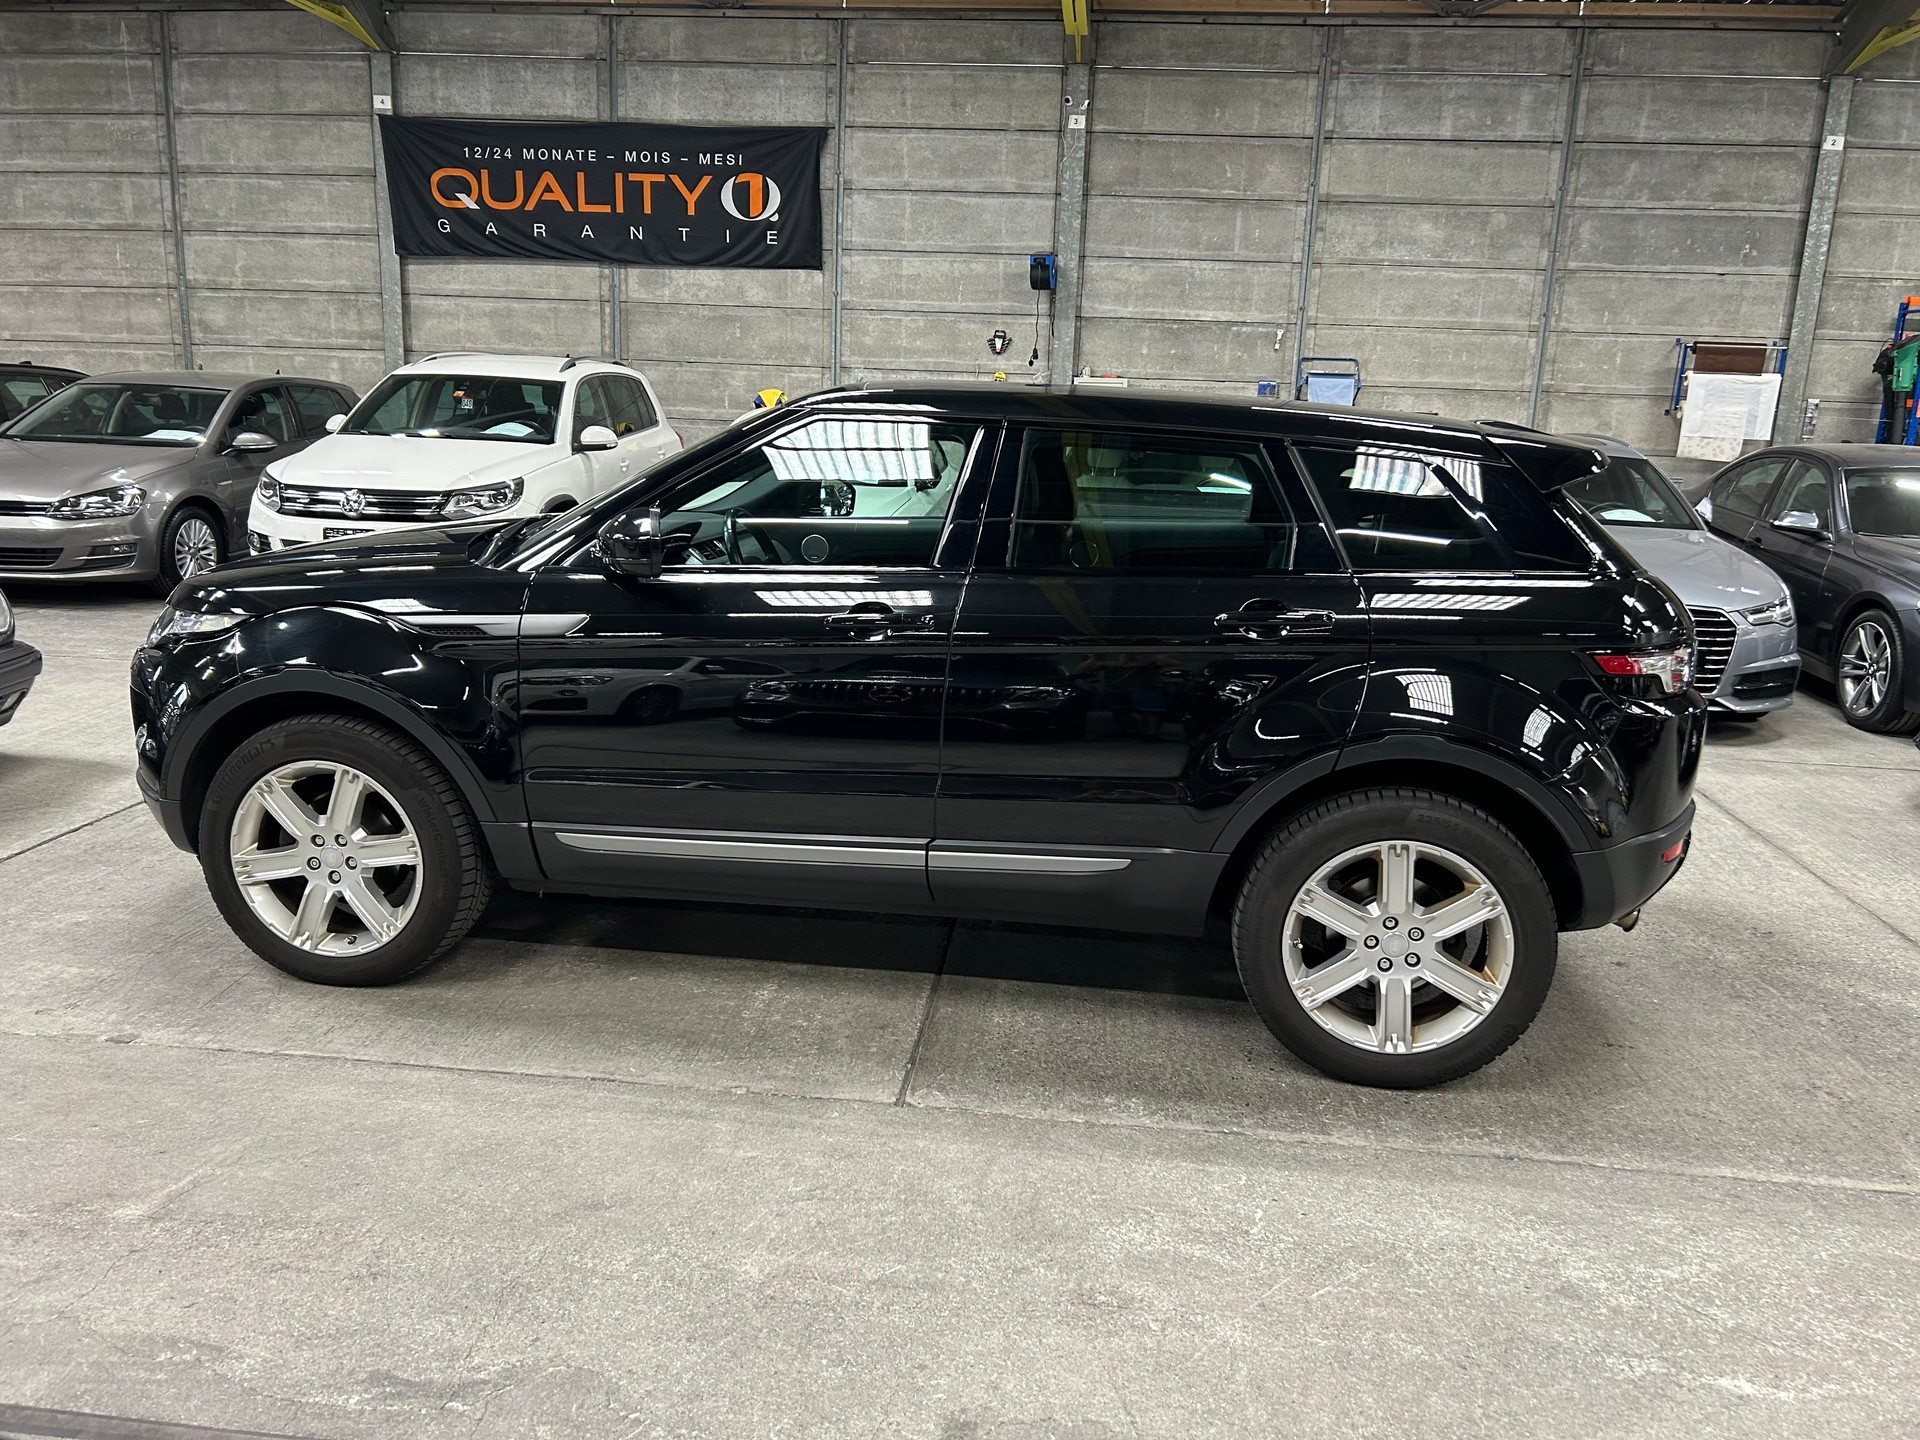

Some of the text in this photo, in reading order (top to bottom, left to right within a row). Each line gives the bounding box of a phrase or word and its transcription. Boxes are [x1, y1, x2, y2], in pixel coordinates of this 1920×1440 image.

[1830, 138, 1837, 147] 2
[463, 147, 513, 160] 12/24
[522, 148, 597, 162] MONATE
[624, 150, 671, 164] MOIS
[698, 153, 743, 166] MESI
[430, 167, 713, 217] QUALITY
[437, 218, 778, 245] GARANTIE
